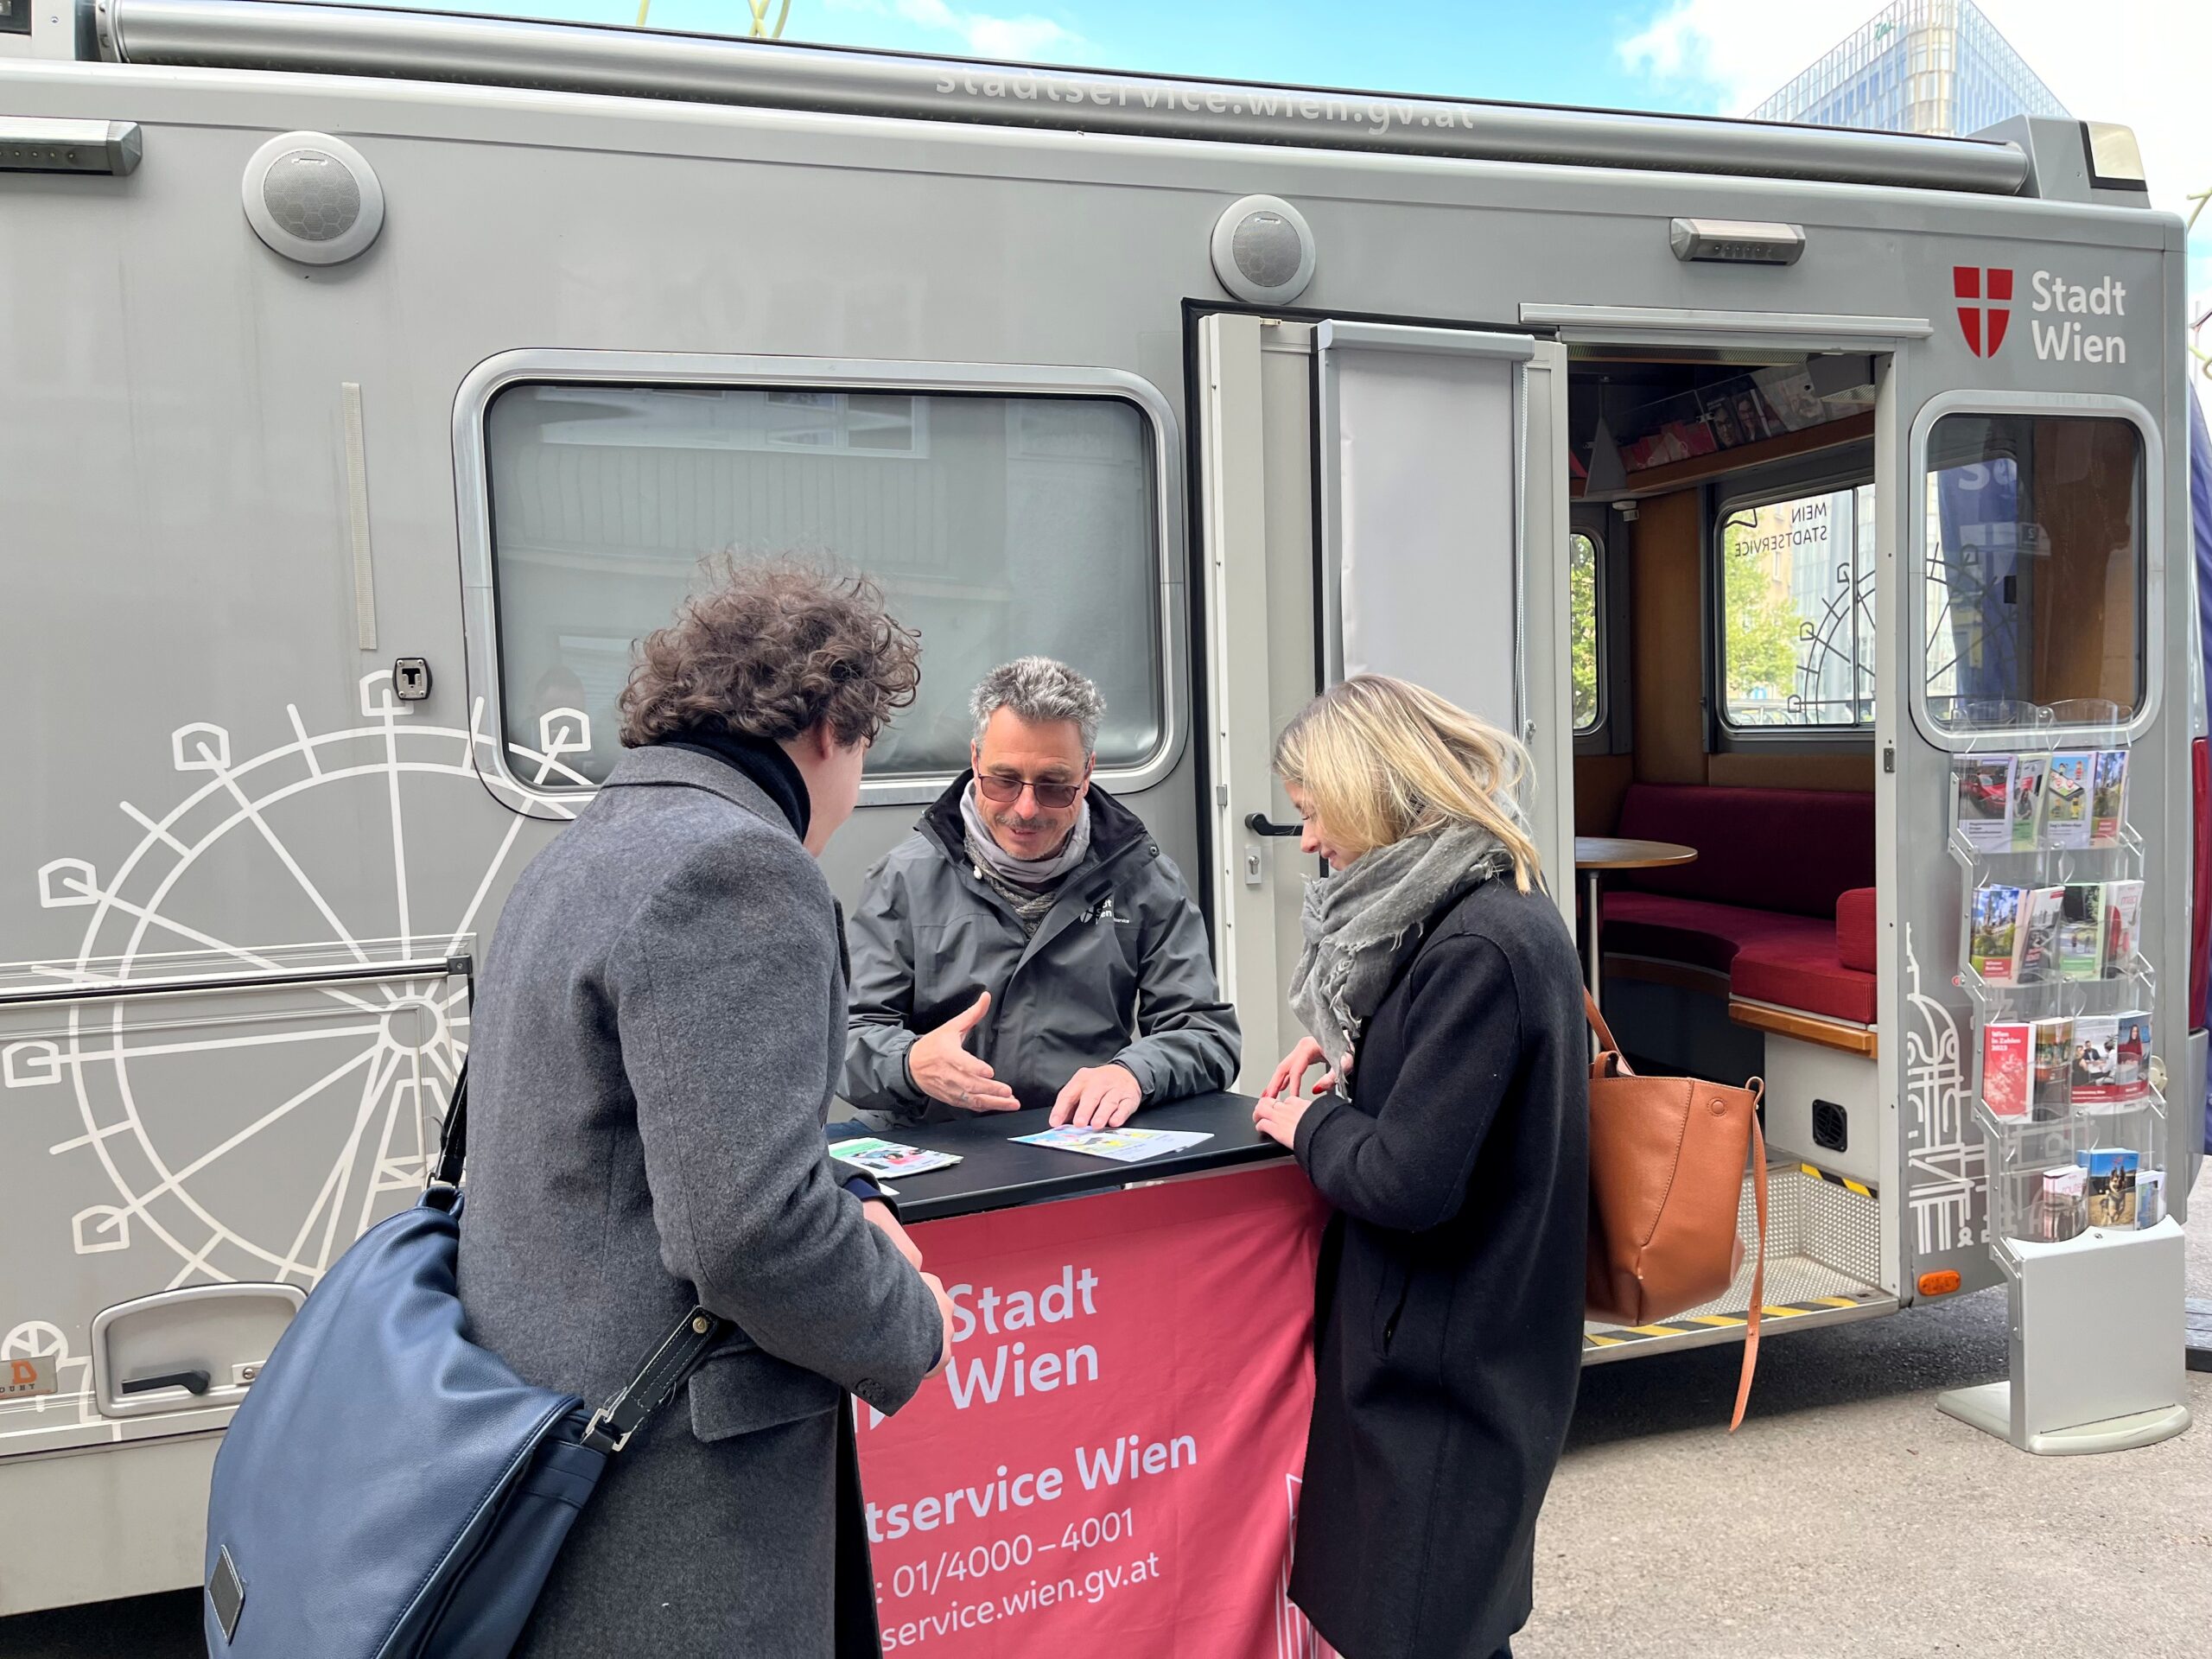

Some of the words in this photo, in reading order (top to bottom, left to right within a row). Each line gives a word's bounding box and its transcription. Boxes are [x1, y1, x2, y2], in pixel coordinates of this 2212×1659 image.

[936, 68, 1475, 134] stadtservice.wien.gv.at
[2031, 270, 2126, 316] Stadt
[2031, 320, 2126, 364] Wien
[946, 1264, 1098, 1343] Stadt
[944, 1342, 1098, 1410] Wien
[1075, 1434, 1197, 1491] Wien
